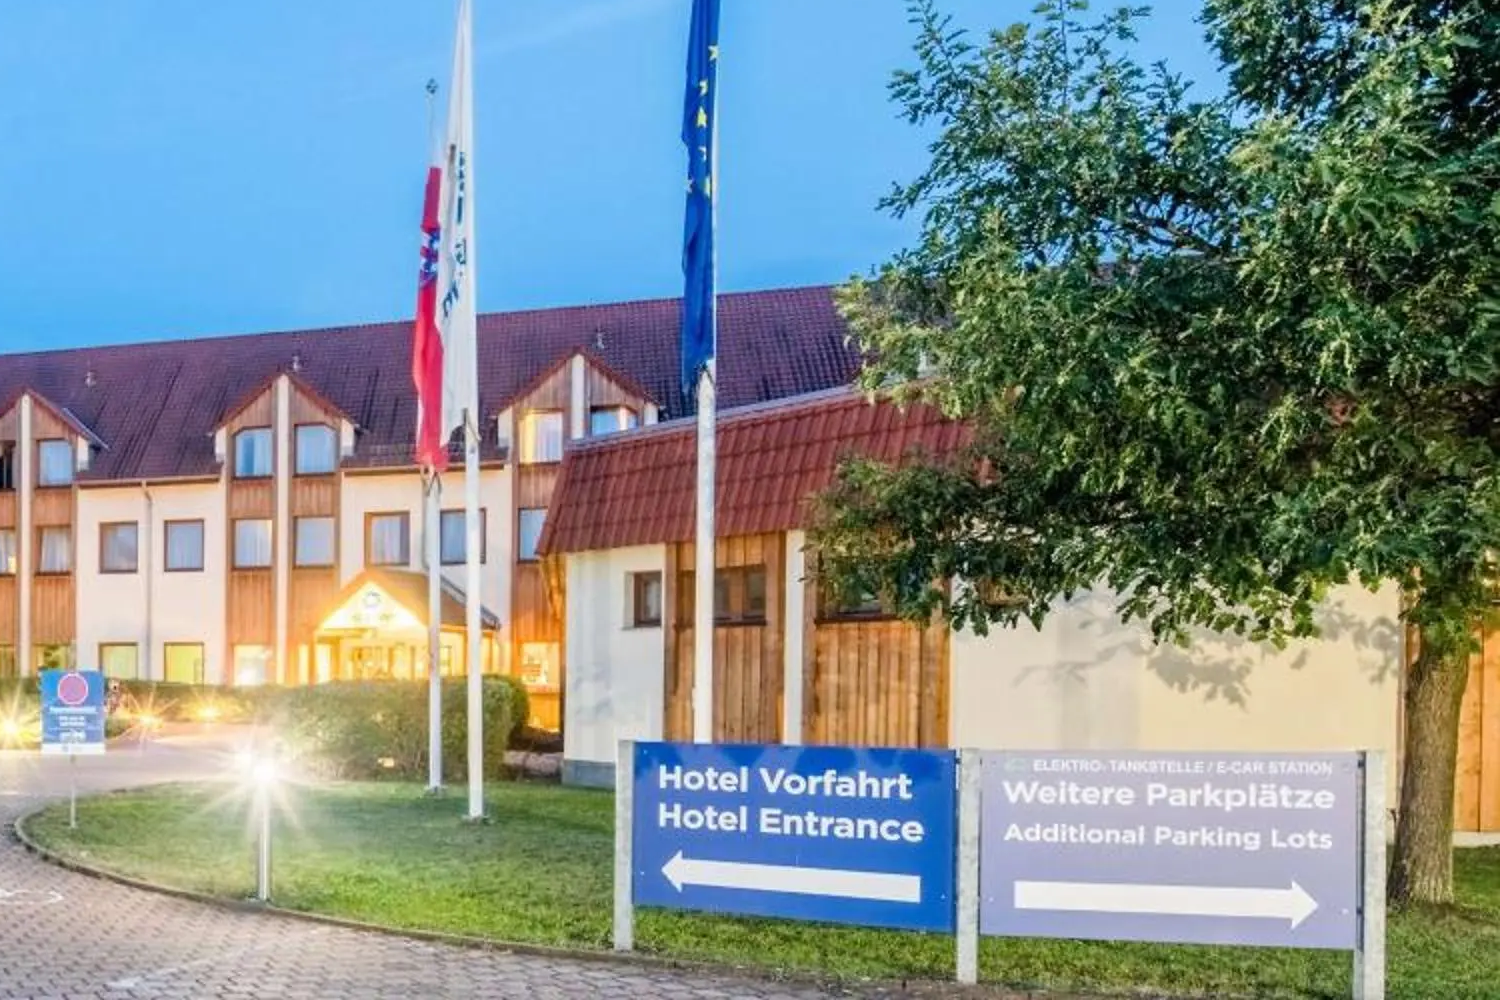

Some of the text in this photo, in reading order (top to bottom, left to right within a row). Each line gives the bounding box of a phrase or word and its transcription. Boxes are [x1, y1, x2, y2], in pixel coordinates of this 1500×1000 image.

[658, 765, 913, 800] Hotel Vorfahrt
[1109, 760, 1205, 774] TANKSTELLE
[1216, 760, 1264, 775] E-CAR
[1267, 760, 1333, 777] STATION
[1002, 780, 1336, 812] Weitere Parkplätze
[658, 803, 925, 843] Hotel Entrance
[1003, 823, 1333, 851] Additional Parking Lots
